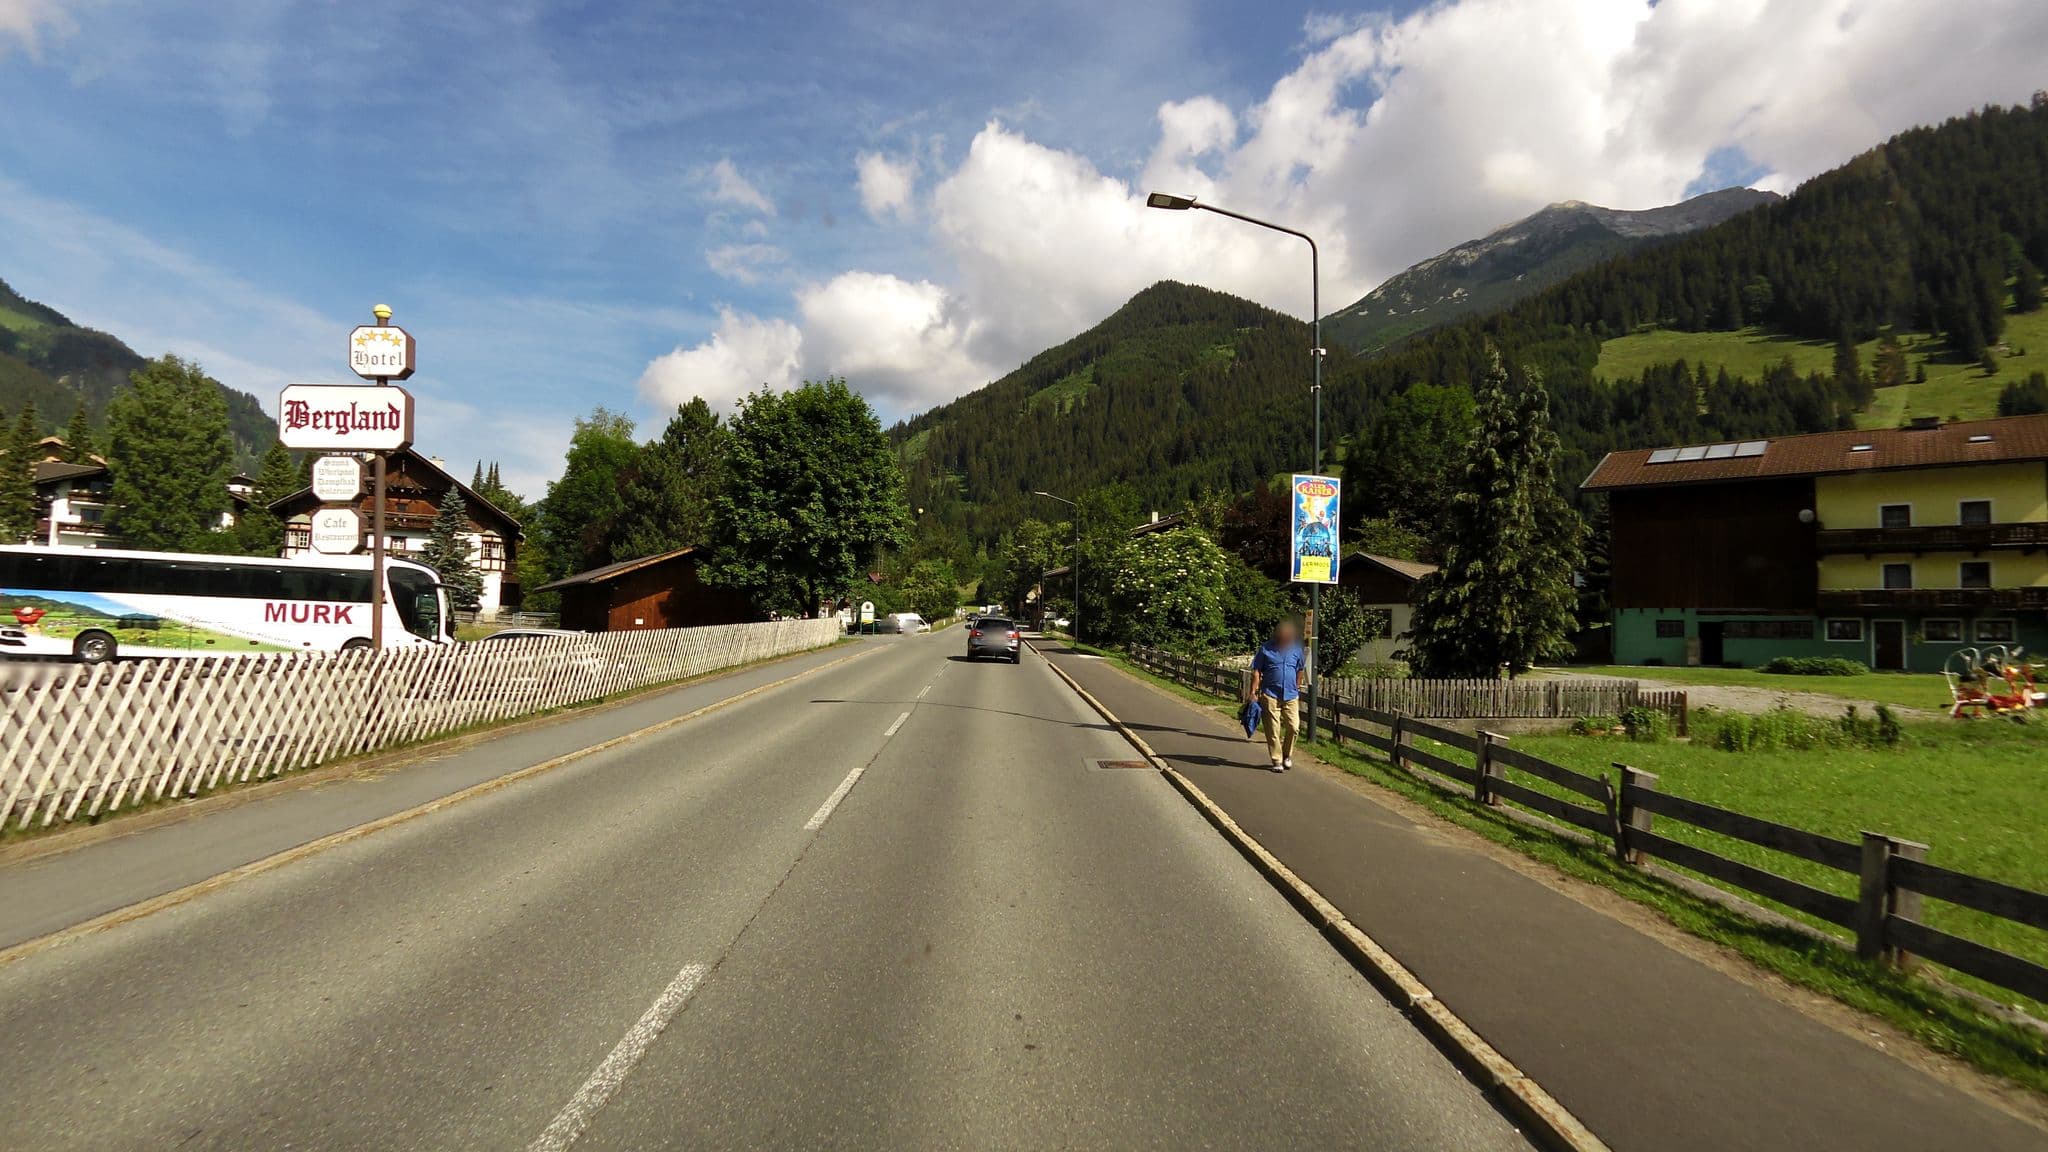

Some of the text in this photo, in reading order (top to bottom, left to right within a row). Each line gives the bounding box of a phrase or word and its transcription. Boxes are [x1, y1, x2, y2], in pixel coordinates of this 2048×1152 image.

[354, 351, 402, 366] Hotel
[284, 400, 401, 435] Bergland
[314, 533, 358, 541] Restaurant
[264, 602, 353, 625] MURK
